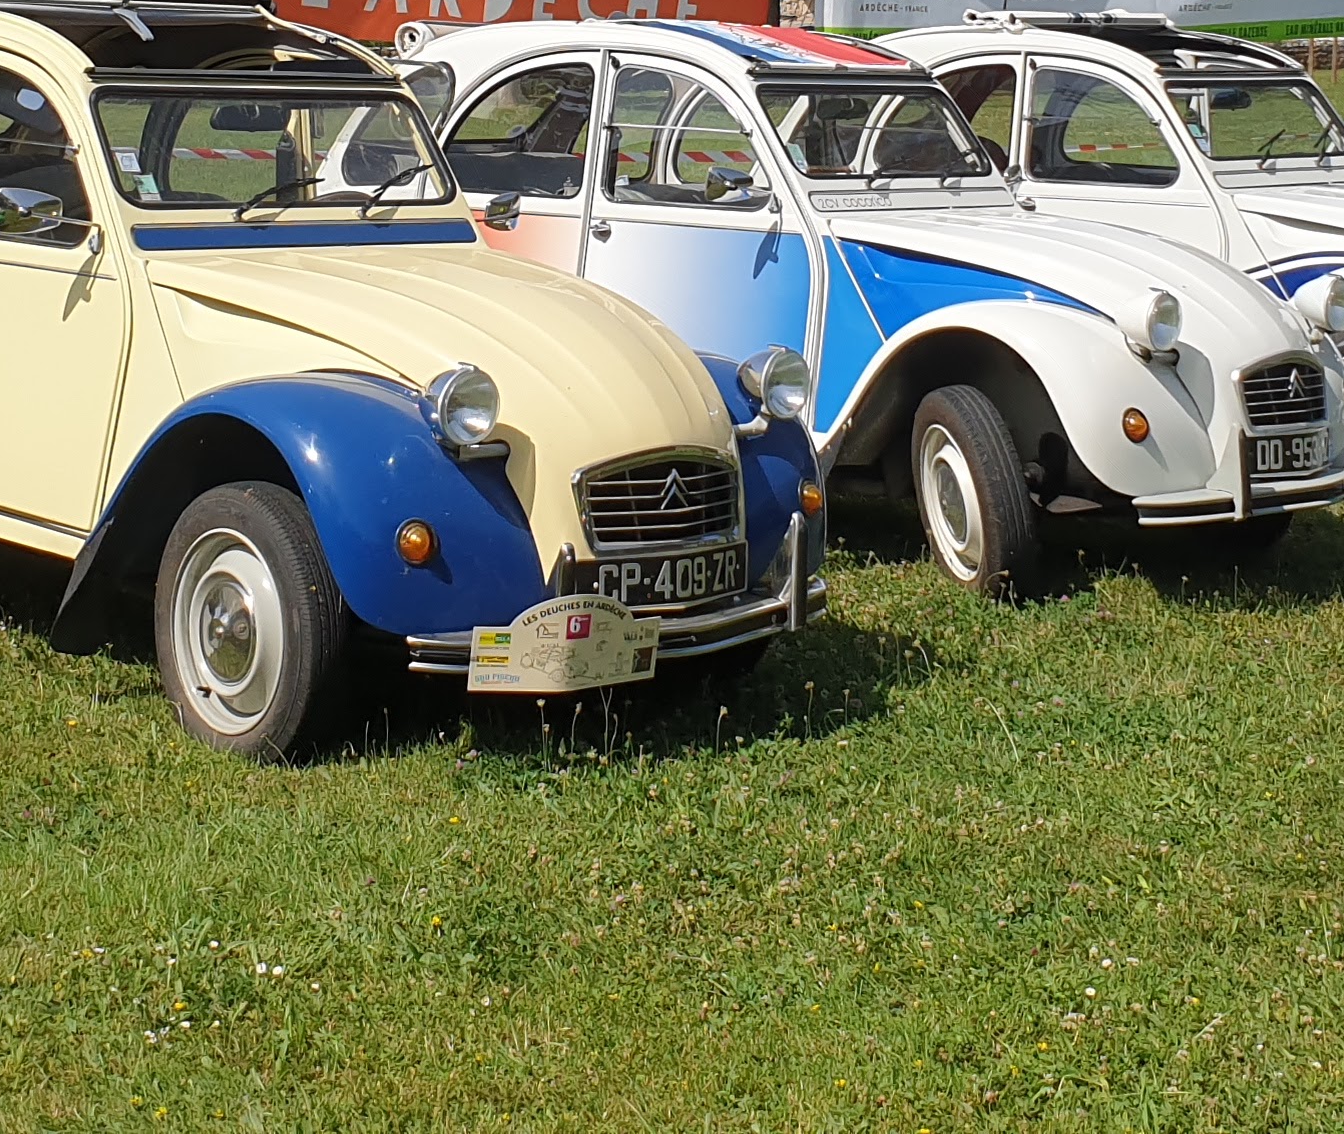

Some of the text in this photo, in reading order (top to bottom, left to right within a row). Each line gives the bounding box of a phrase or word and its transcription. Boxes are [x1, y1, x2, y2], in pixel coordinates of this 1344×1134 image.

[521, 600, 628, 627] LES DEUCHES EN ARDÈCHE
